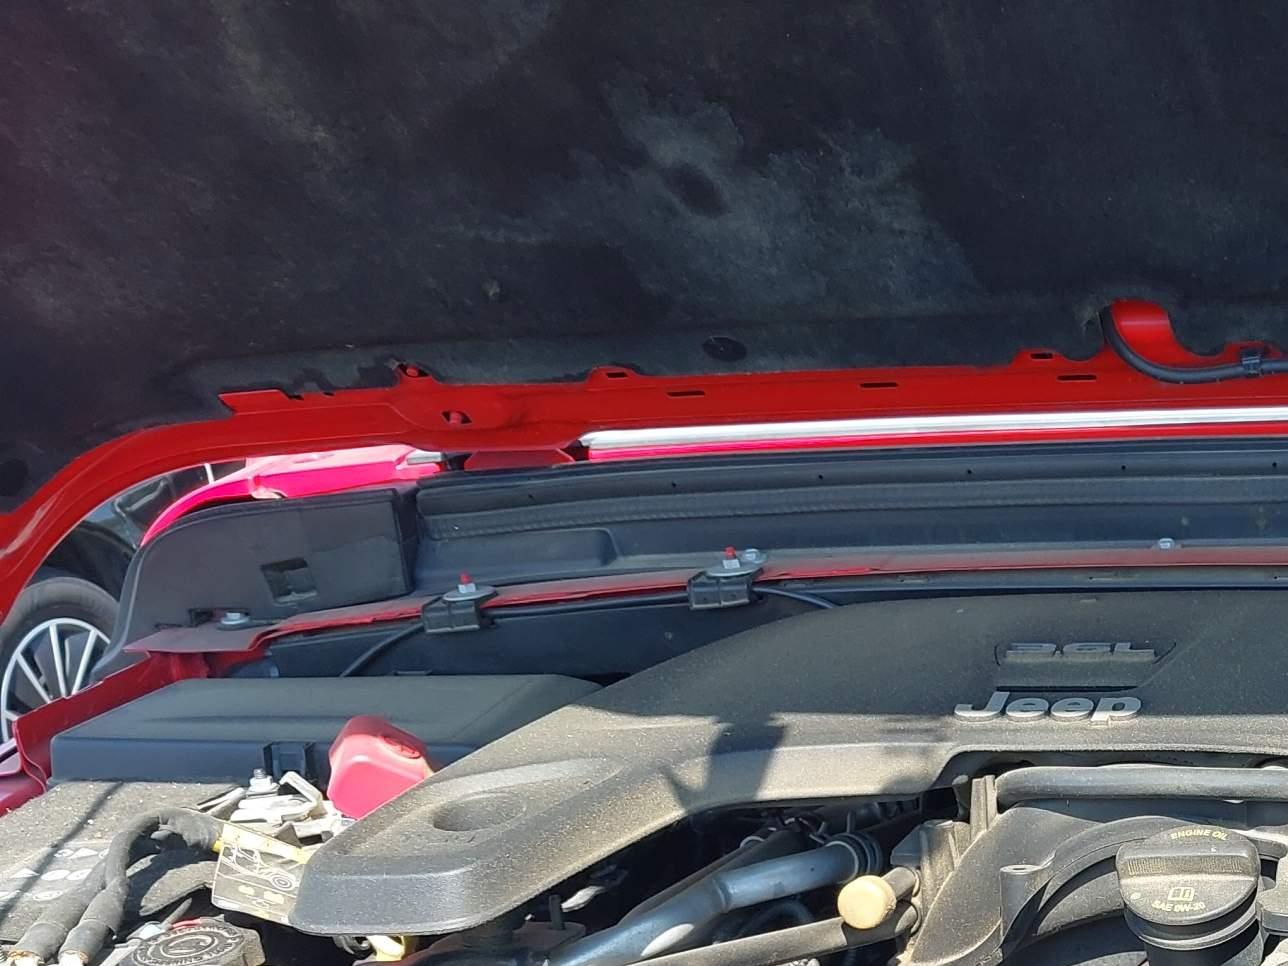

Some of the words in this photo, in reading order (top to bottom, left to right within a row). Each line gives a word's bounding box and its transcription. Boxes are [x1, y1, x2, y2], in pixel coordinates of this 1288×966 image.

[953, 691, 1142, 725] Jeep
[1170, 829, 1211, 840] ENGINE
[1212, 831, 1229, 841] OIL
[1151, 900, 1174, 912] SAE
[1174, 902, 1206, 912] 0W-20
